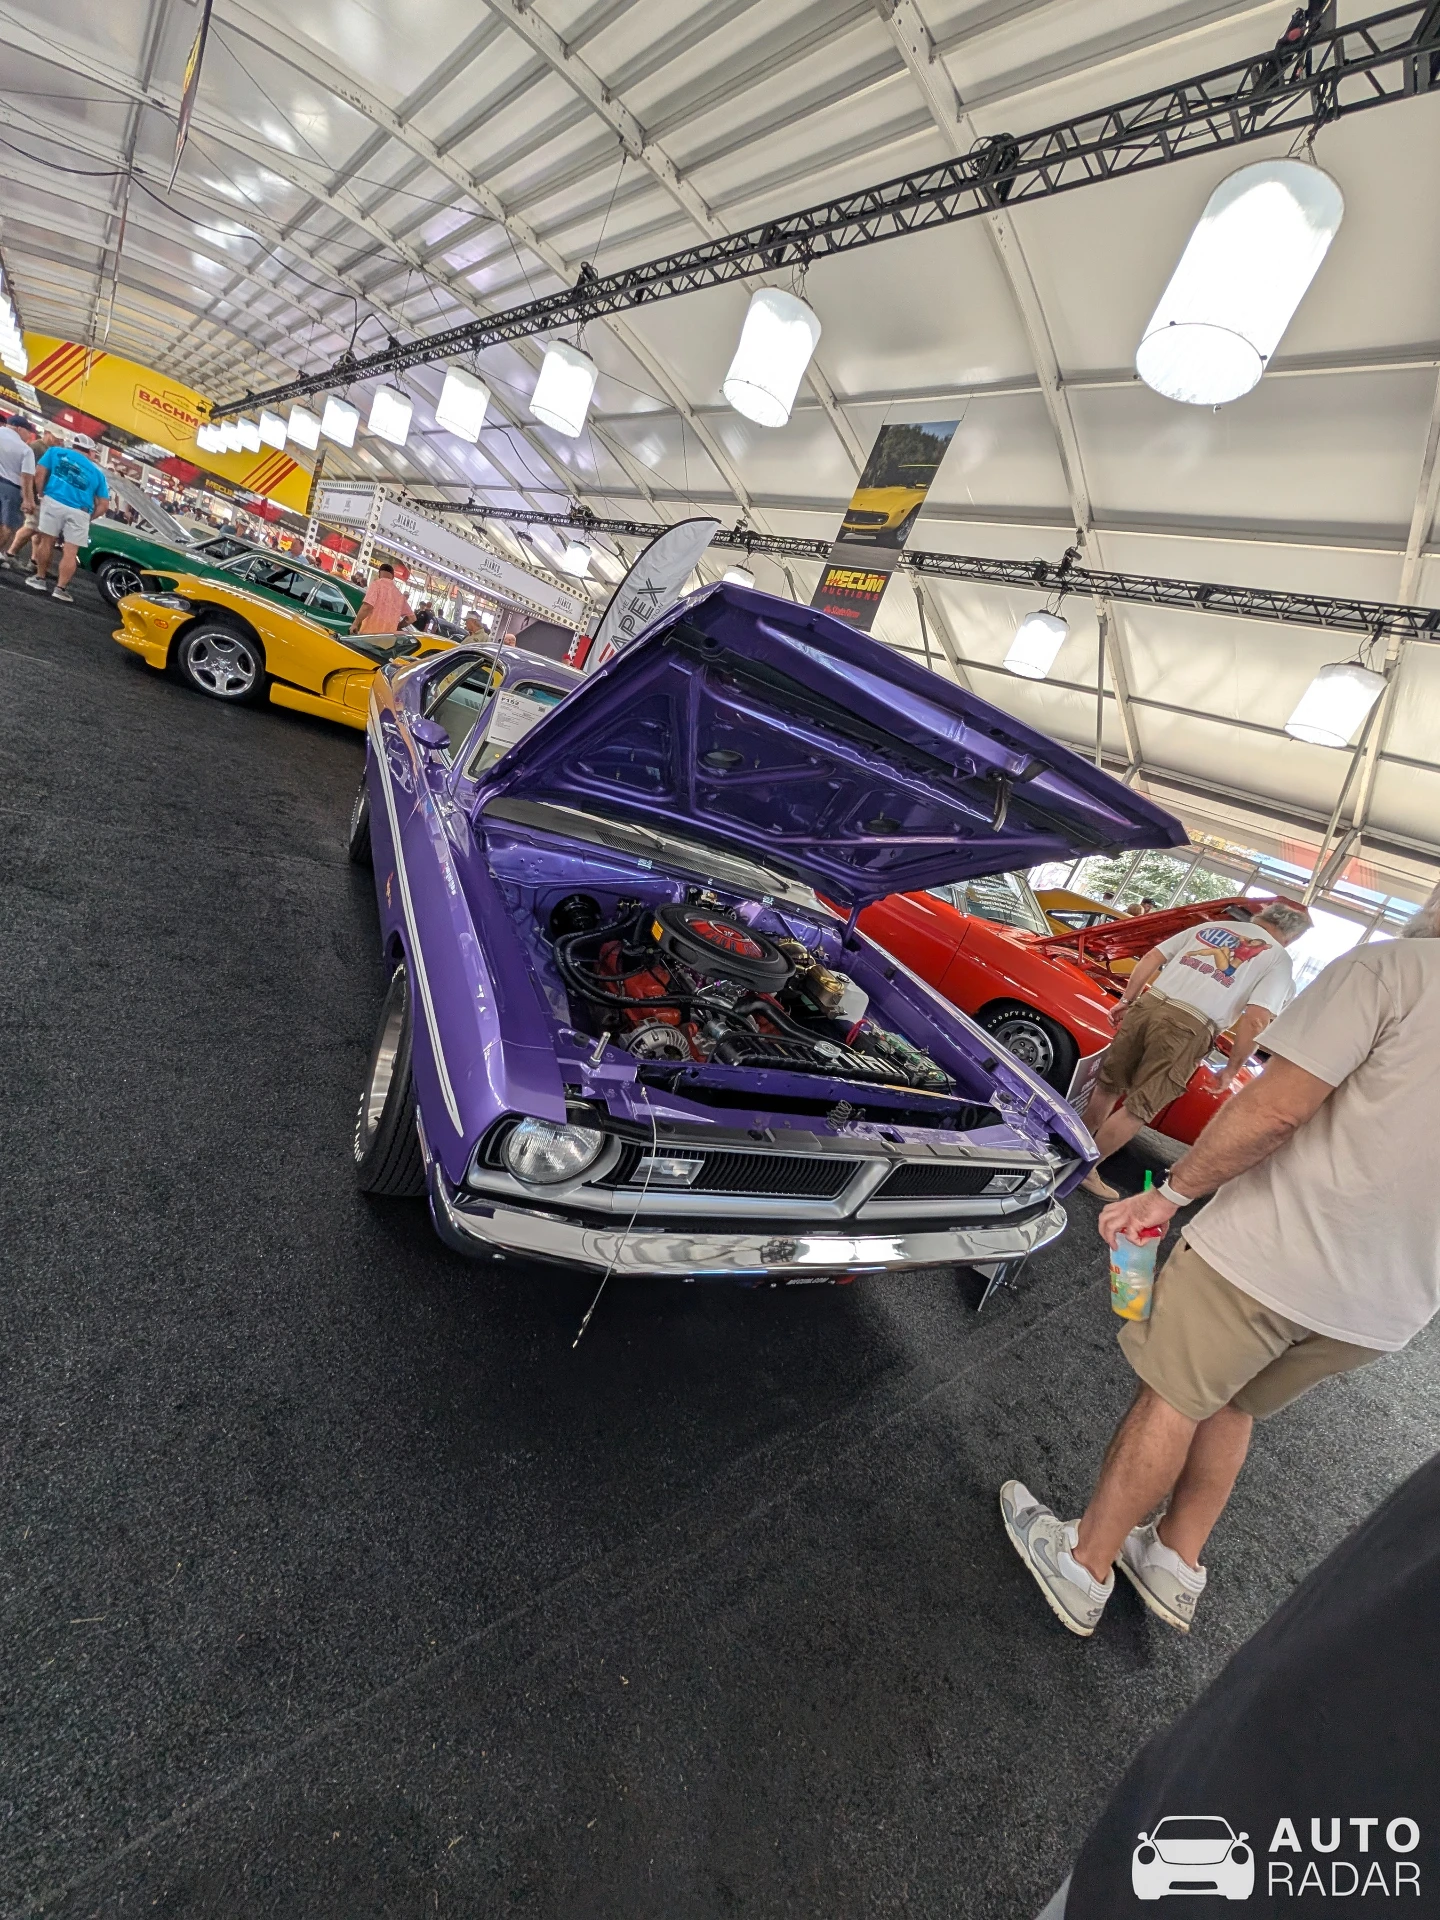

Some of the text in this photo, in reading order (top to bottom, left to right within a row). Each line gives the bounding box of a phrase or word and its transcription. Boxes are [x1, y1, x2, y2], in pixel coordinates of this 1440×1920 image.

[138, 389, 206, 427] BACHM
[825, 569, 886, 593] MECUM
[821, 586, 879, 601] AUCTIONS
[617, 599, 630, 615] THE
[987, 1010, 1041, 1028] GOODYEAR
